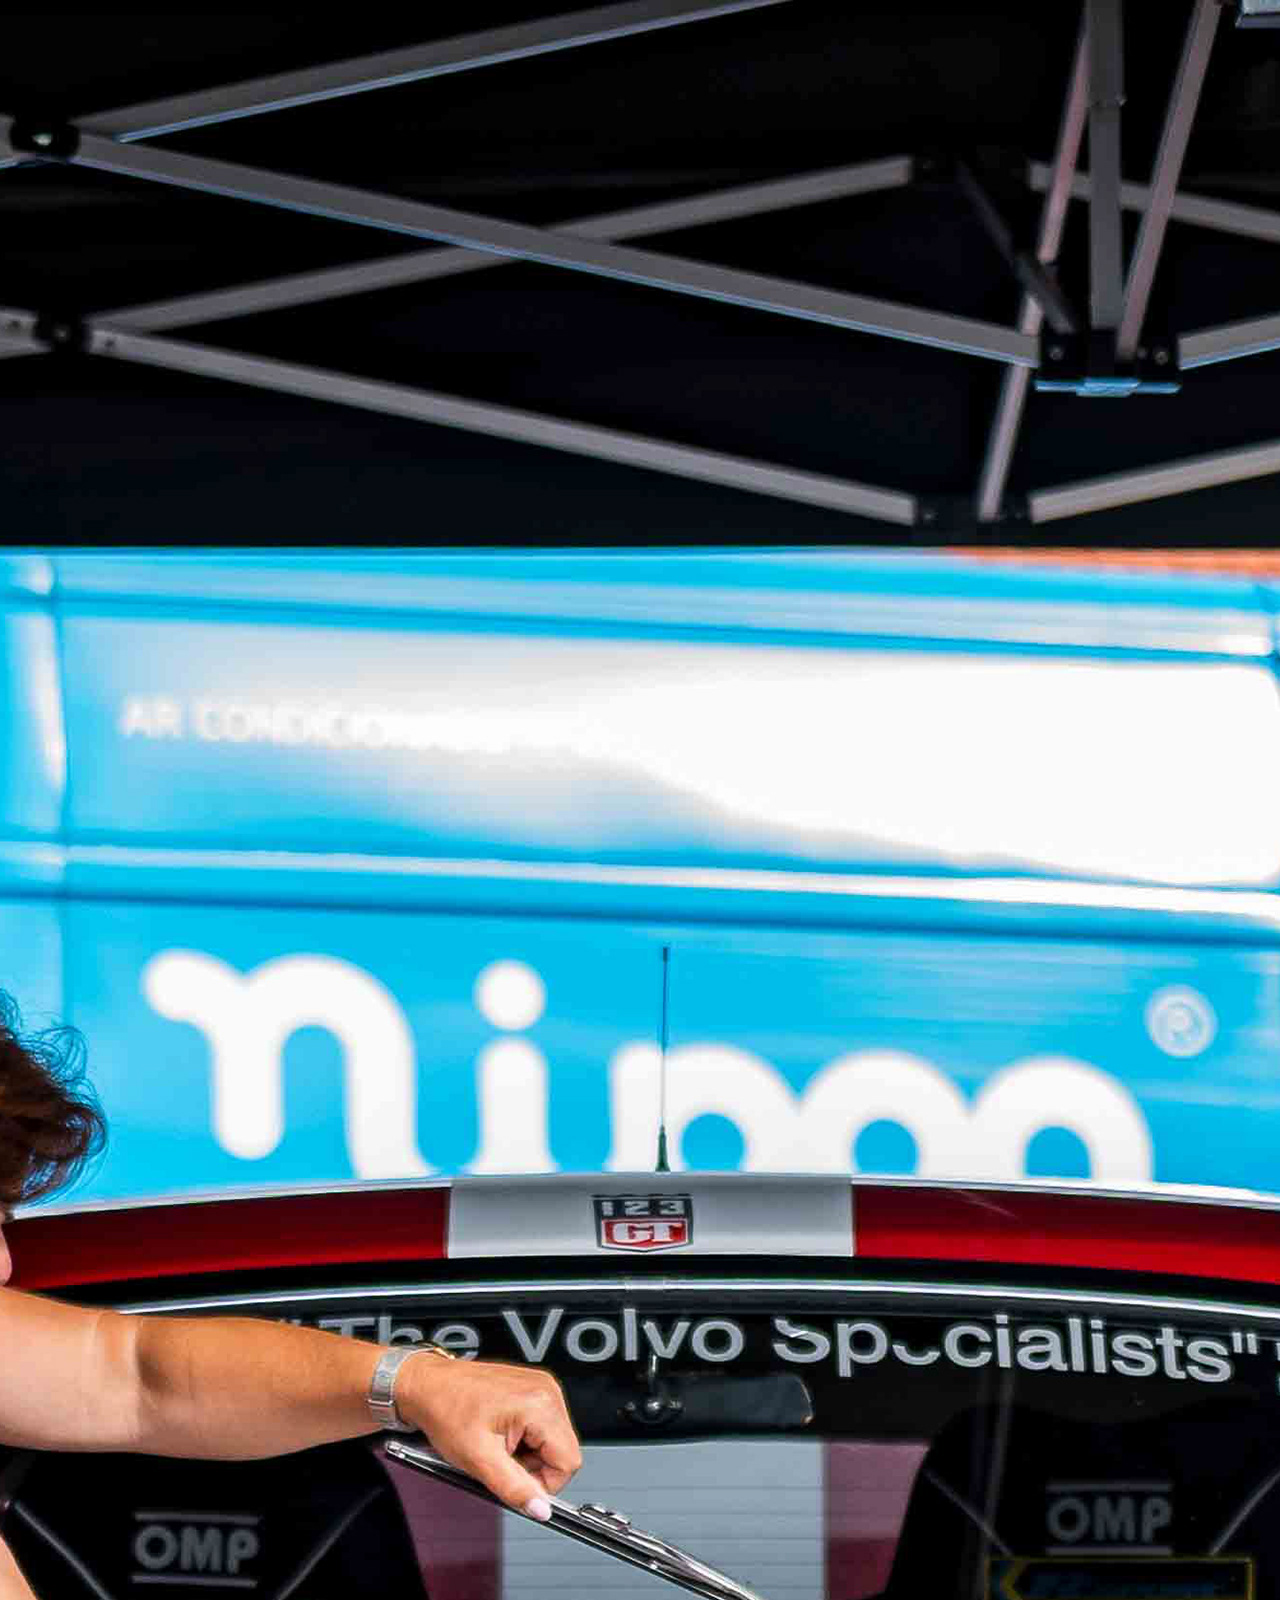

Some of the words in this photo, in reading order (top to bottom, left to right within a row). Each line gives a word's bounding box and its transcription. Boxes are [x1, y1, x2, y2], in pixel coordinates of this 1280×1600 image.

[280, 1314, 481, 1361] The
[503, 1308, 744, 1363] Volvo
[1046, 1496, 1170, 1542] OMP
[134, 1525, 259, 1574] OMP
